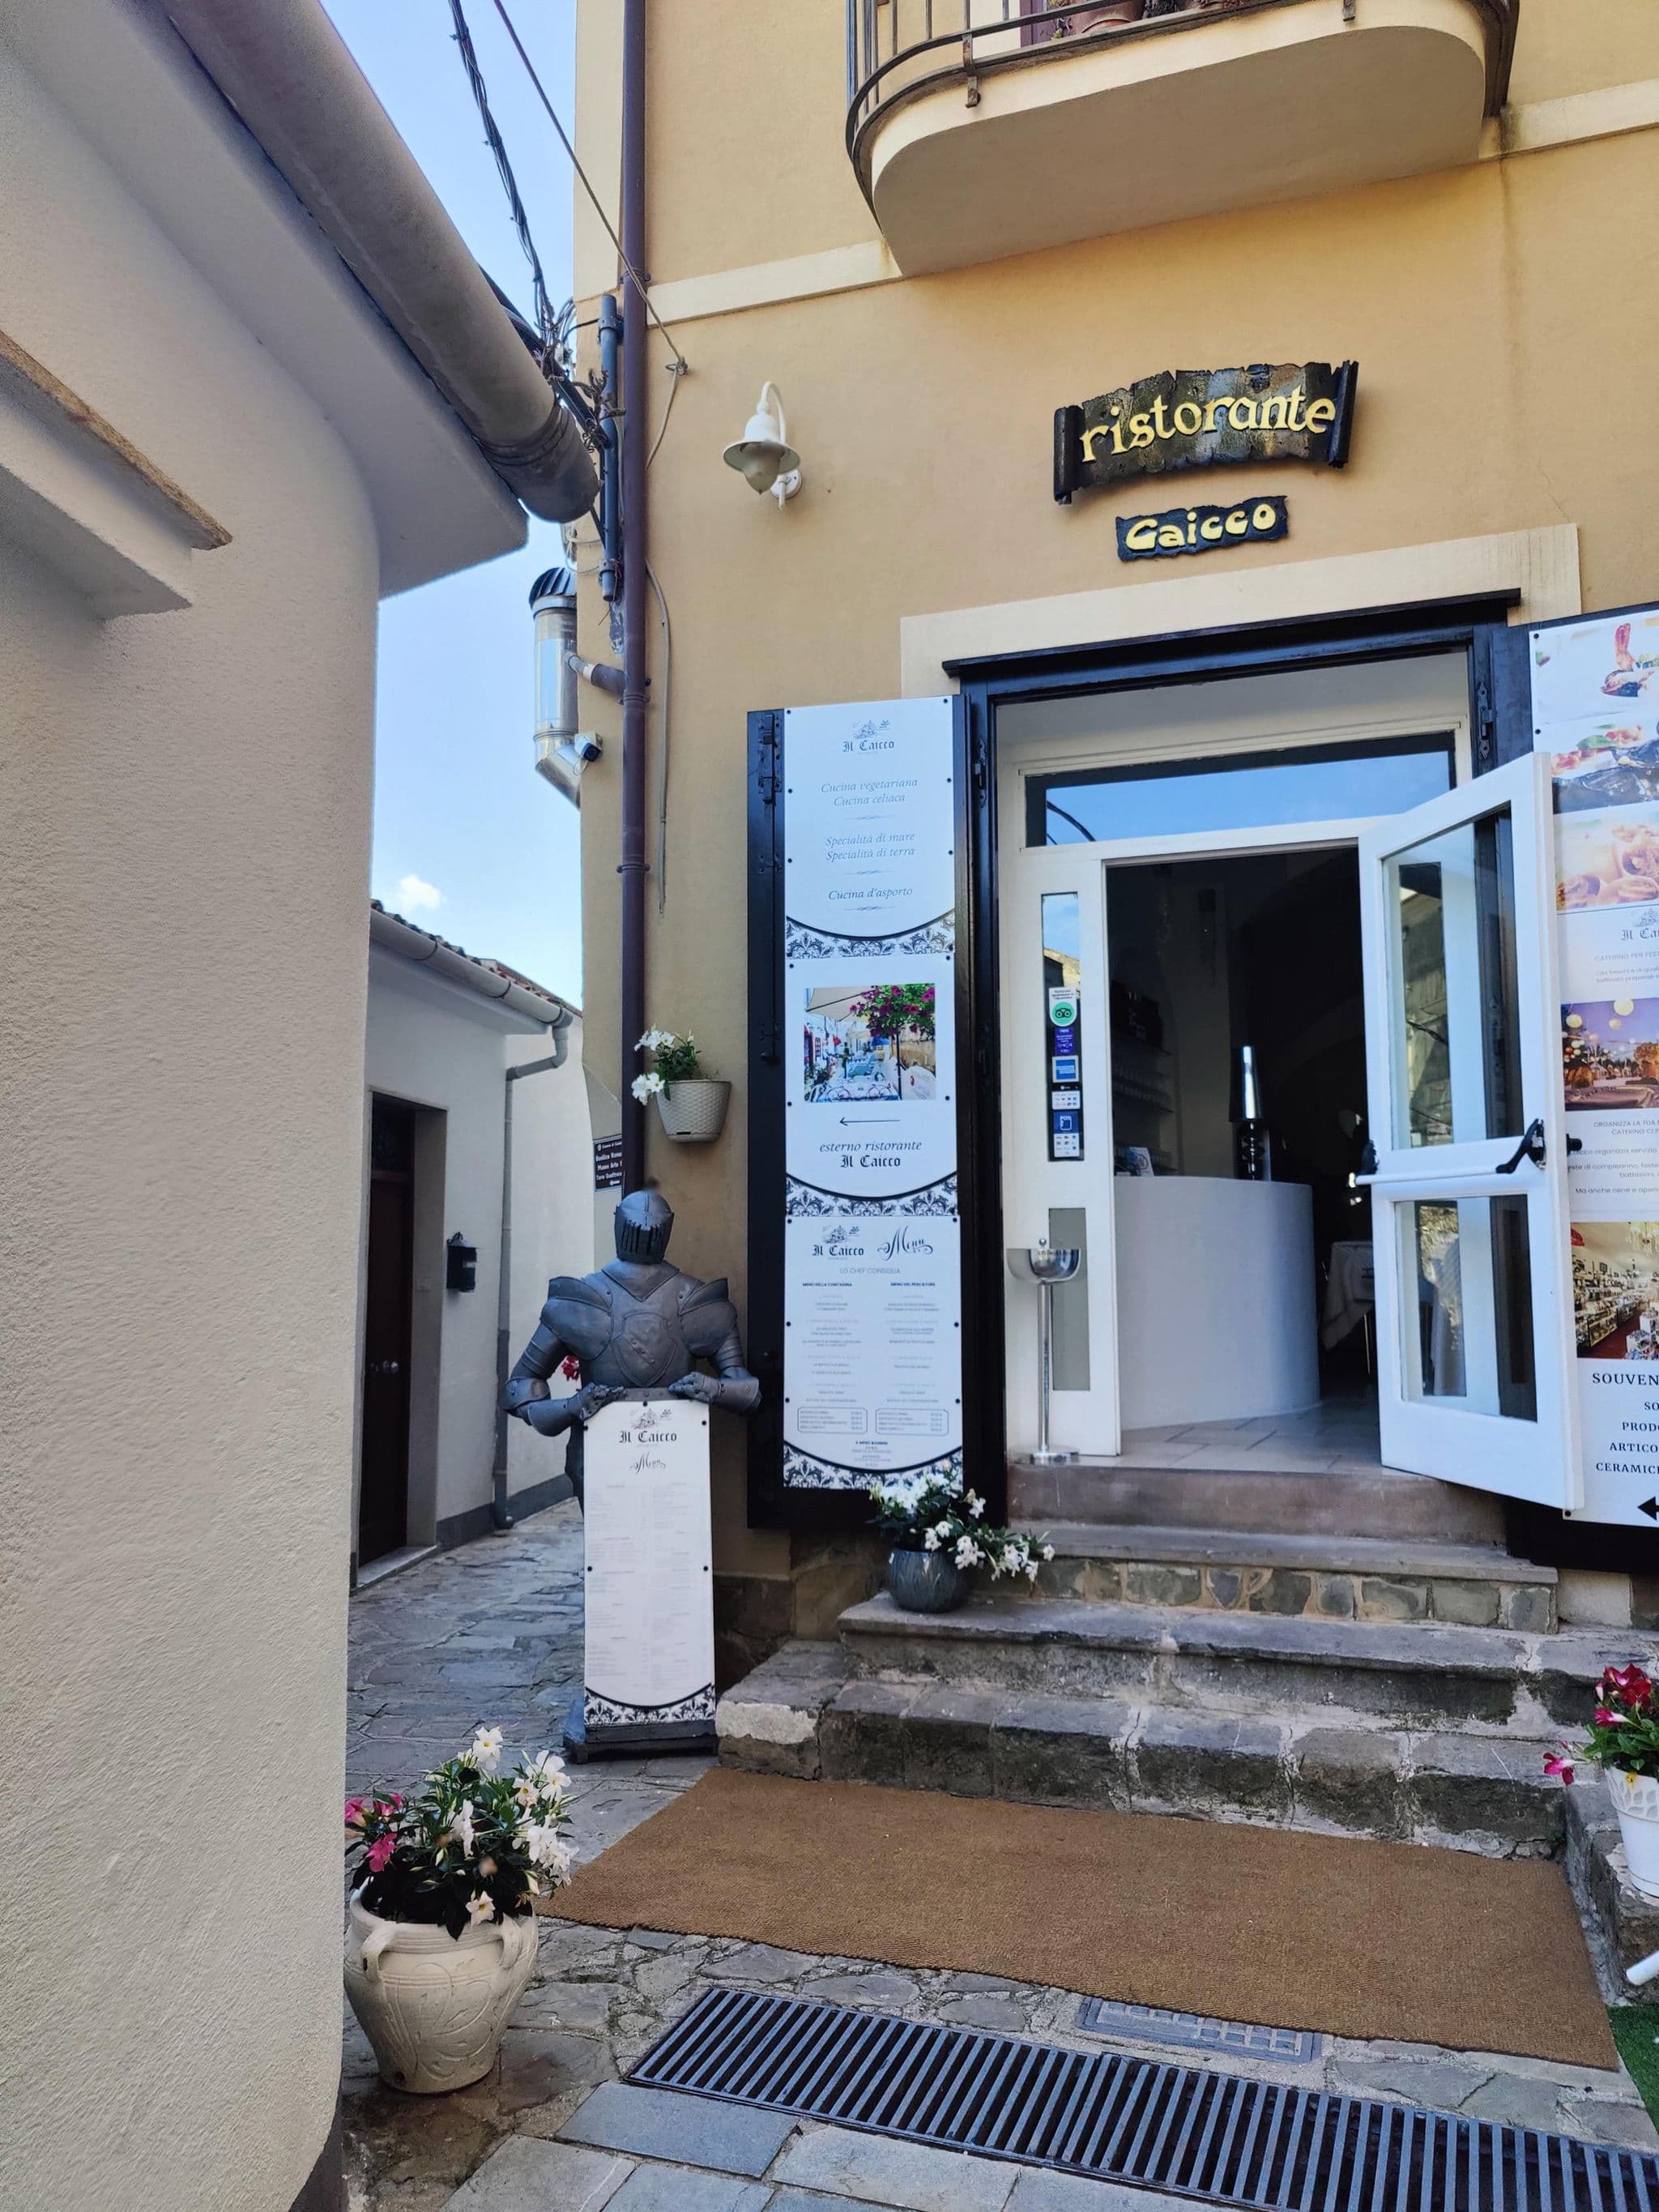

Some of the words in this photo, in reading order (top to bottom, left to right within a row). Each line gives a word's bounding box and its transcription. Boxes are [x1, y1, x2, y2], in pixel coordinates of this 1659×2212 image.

[1079, 385, 1337, 463] ristorante
[842, 741, 854, 753] Il
[859, 740, 895, 752] Caicco
[821, 783, 856, 794] Cucina
[859, 778, 918, 792] vegetariana
[834, 796, 869, 807] Cucina
[872, 793, 906, 805] celiaca
[876, 834, 887, 844] di
[889, 833, 915, 843] mare
[876, 848, 888, 857] di
[889, 848, 915, 856] terra
[828, 890, 864, 901] Cucina
[867, 887, 914, 900] d'asporto
[820, 1142, 861, 1152] esterno
[865, 1141, 923, 1152] ristorante
[840, 1155, 854, 1168] Il
[859, 1155, 901, 1168] Caicco
[812, 1245, 823, 1257] Il
[829, 1244, 864, 1257] Caicco
[1593, 1373, 1659, 1386] SOUVEN
[1622, 1421, 1659, 1432] PROD
[619, 1431, 632, 1444] Il
[638, 1430, 677, 1443] Caicco
[1610, 1442, 1658, 1453] ARTICO
